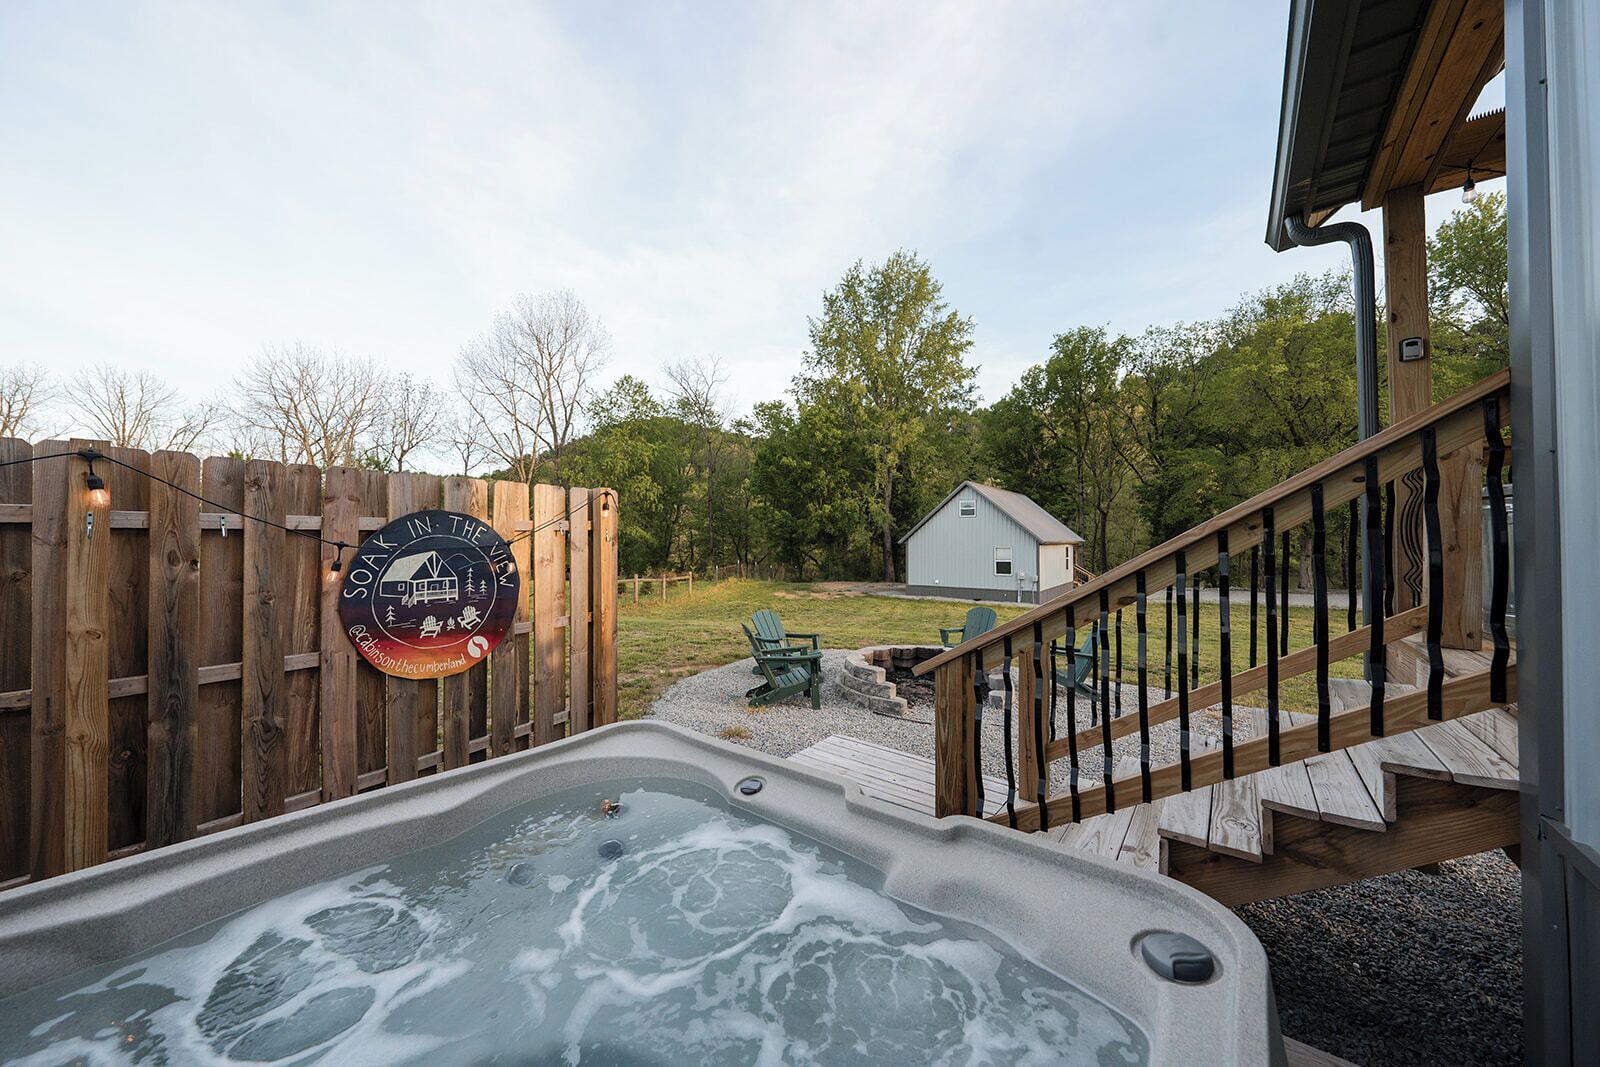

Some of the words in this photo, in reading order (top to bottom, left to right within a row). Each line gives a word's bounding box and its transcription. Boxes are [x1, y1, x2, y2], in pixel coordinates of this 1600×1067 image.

[343, 534, 398, 599] SOAK
[407, 516, 432, 538] IN
[449, 515, 487, 545] THE
[489, 541, 514, 587] VIEW
[348, 624, 466, 674] @cabinsonthecumberland
